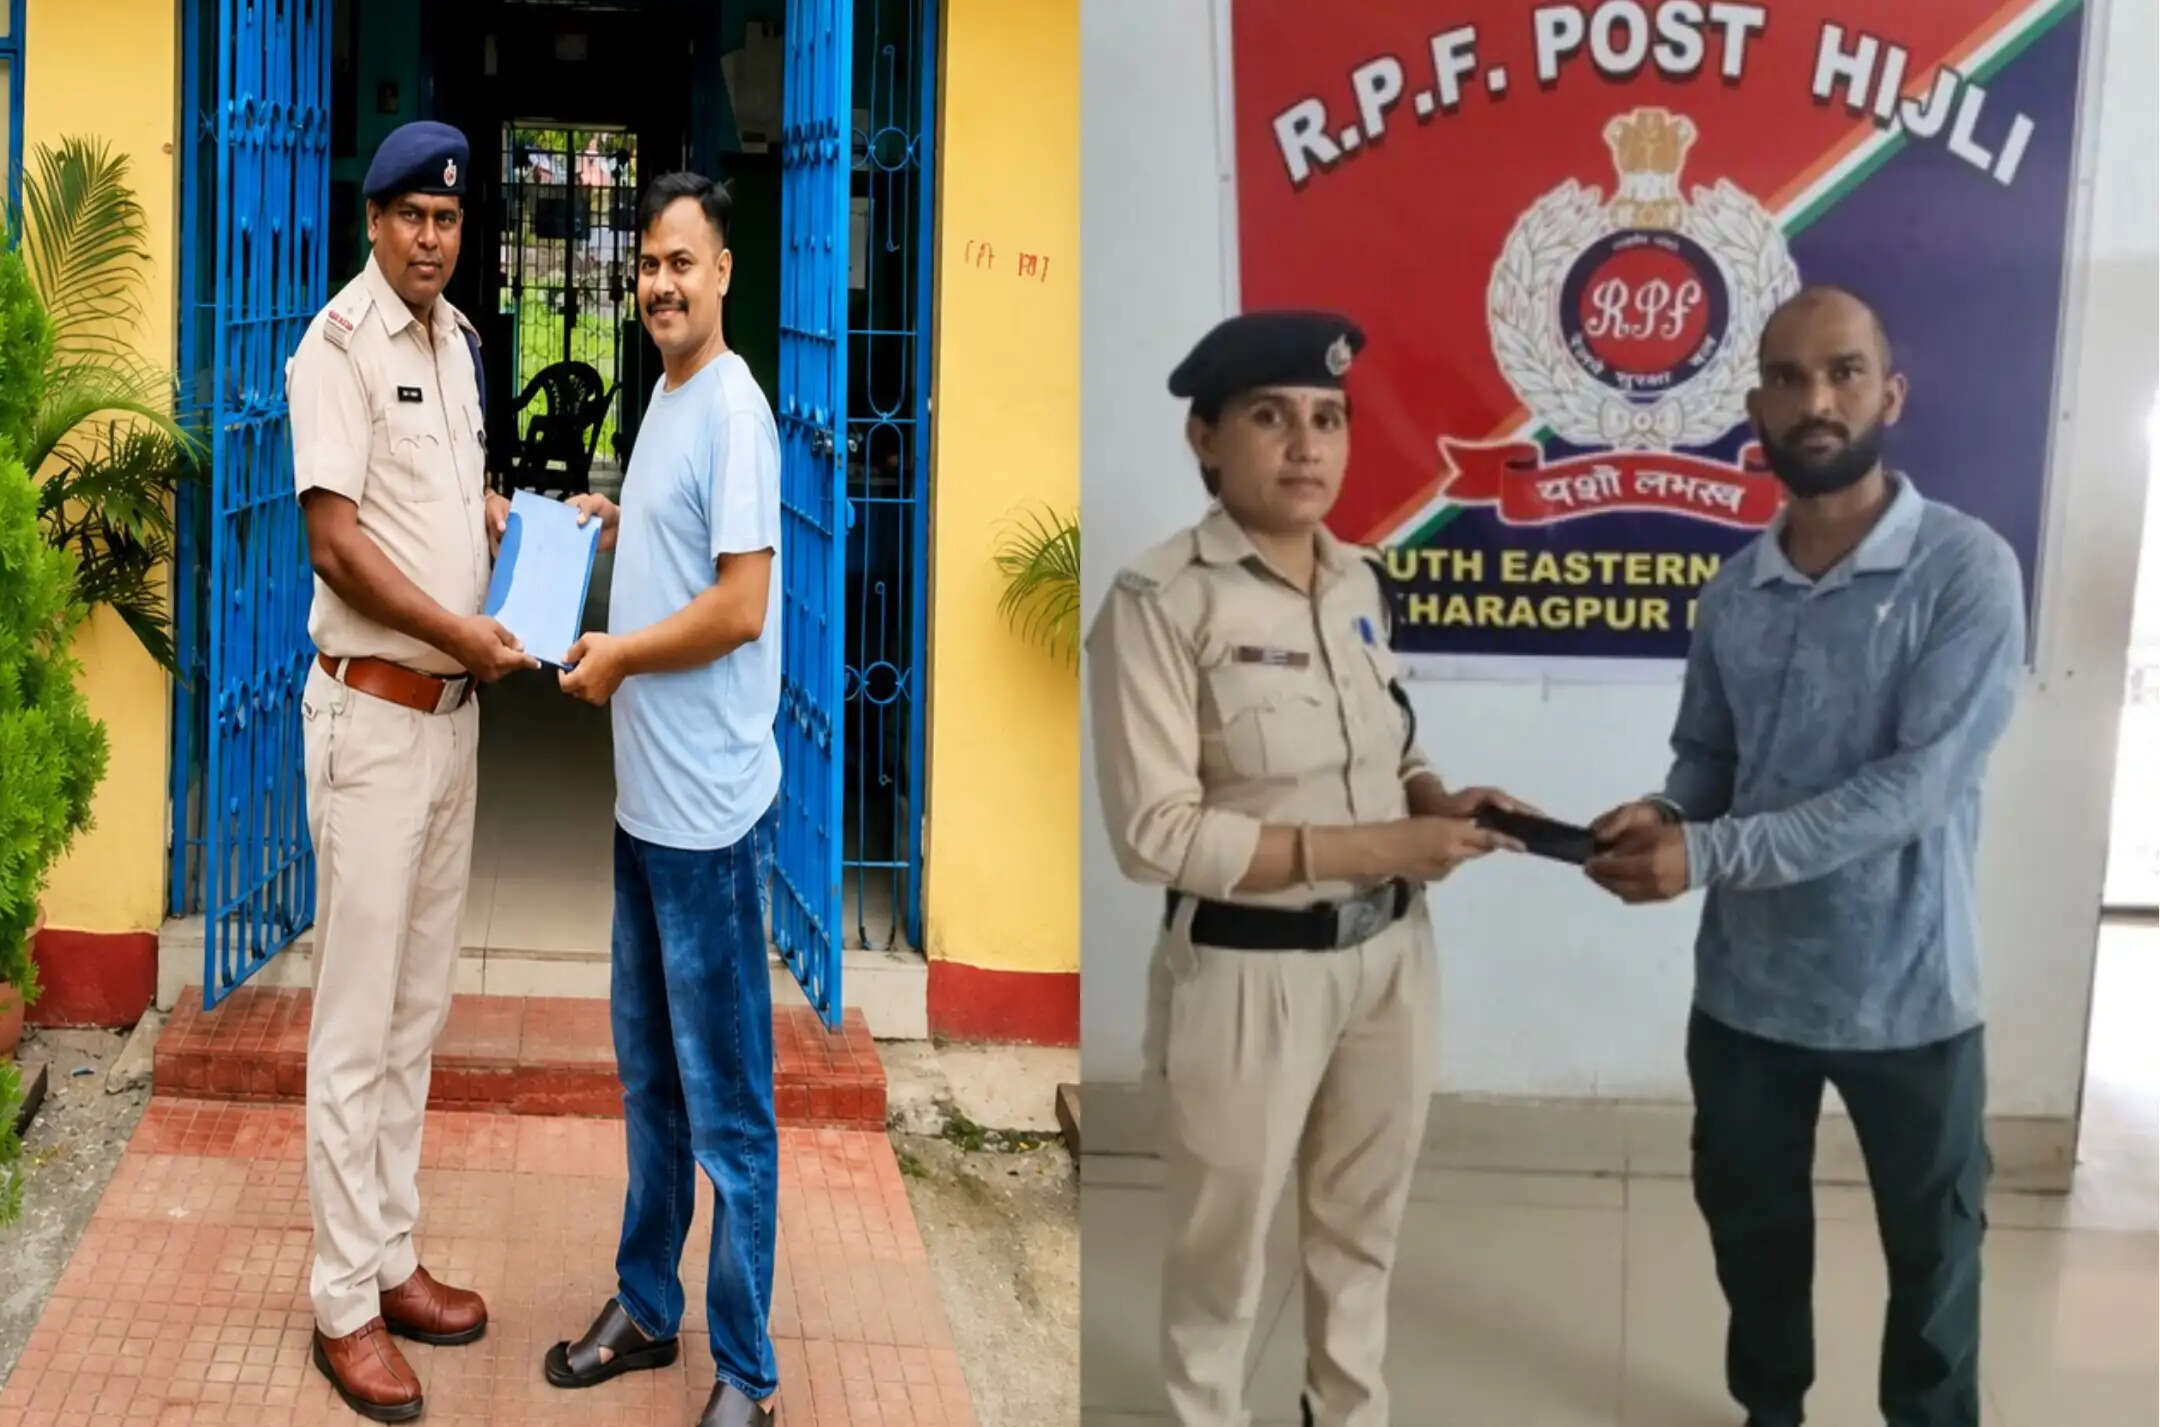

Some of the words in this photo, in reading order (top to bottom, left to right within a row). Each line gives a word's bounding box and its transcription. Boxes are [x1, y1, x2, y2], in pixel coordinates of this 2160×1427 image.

[1272, 25, 1507, 183] R.P.F.
[1533, 0, 1767, 81] POST
[1812, 23, 2035, 186] HIJLI
[1386, 549, 1484, 582] UTH
[1501, 550, 1720, 585] EASTERN
[1397, 592, 1670, 631] HARAGPUR
